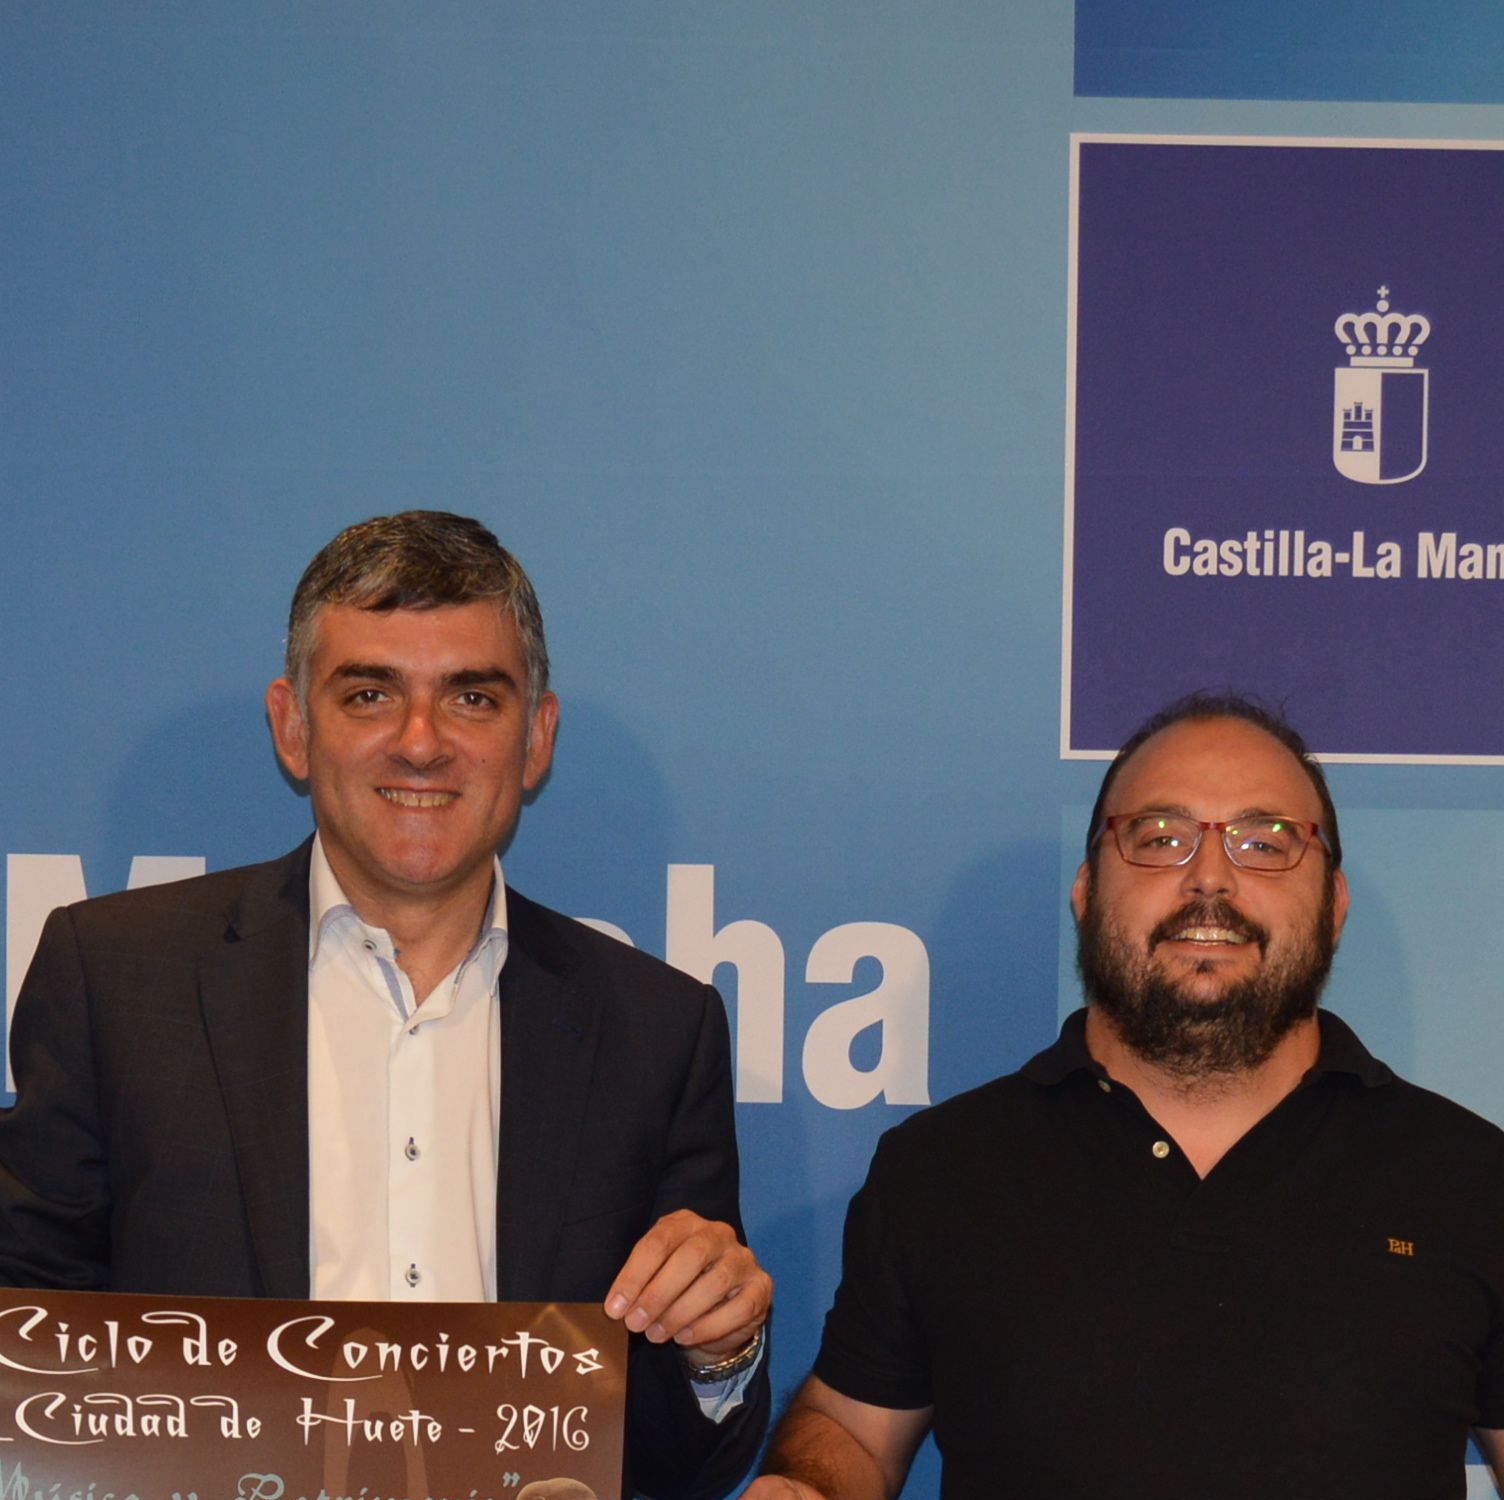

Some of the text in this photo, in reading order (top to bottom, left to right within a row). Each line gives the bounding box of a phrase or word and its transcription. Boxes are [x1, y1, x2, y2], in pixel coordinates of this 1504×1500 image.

[1163, 527, 1401, 578] Castilla-La
[142, 1311, 238, 1367] de
[267, 1315, 604, 1381] Conciertos
[14, 1392, 590, 1453] Ciudad de Huete 2016
